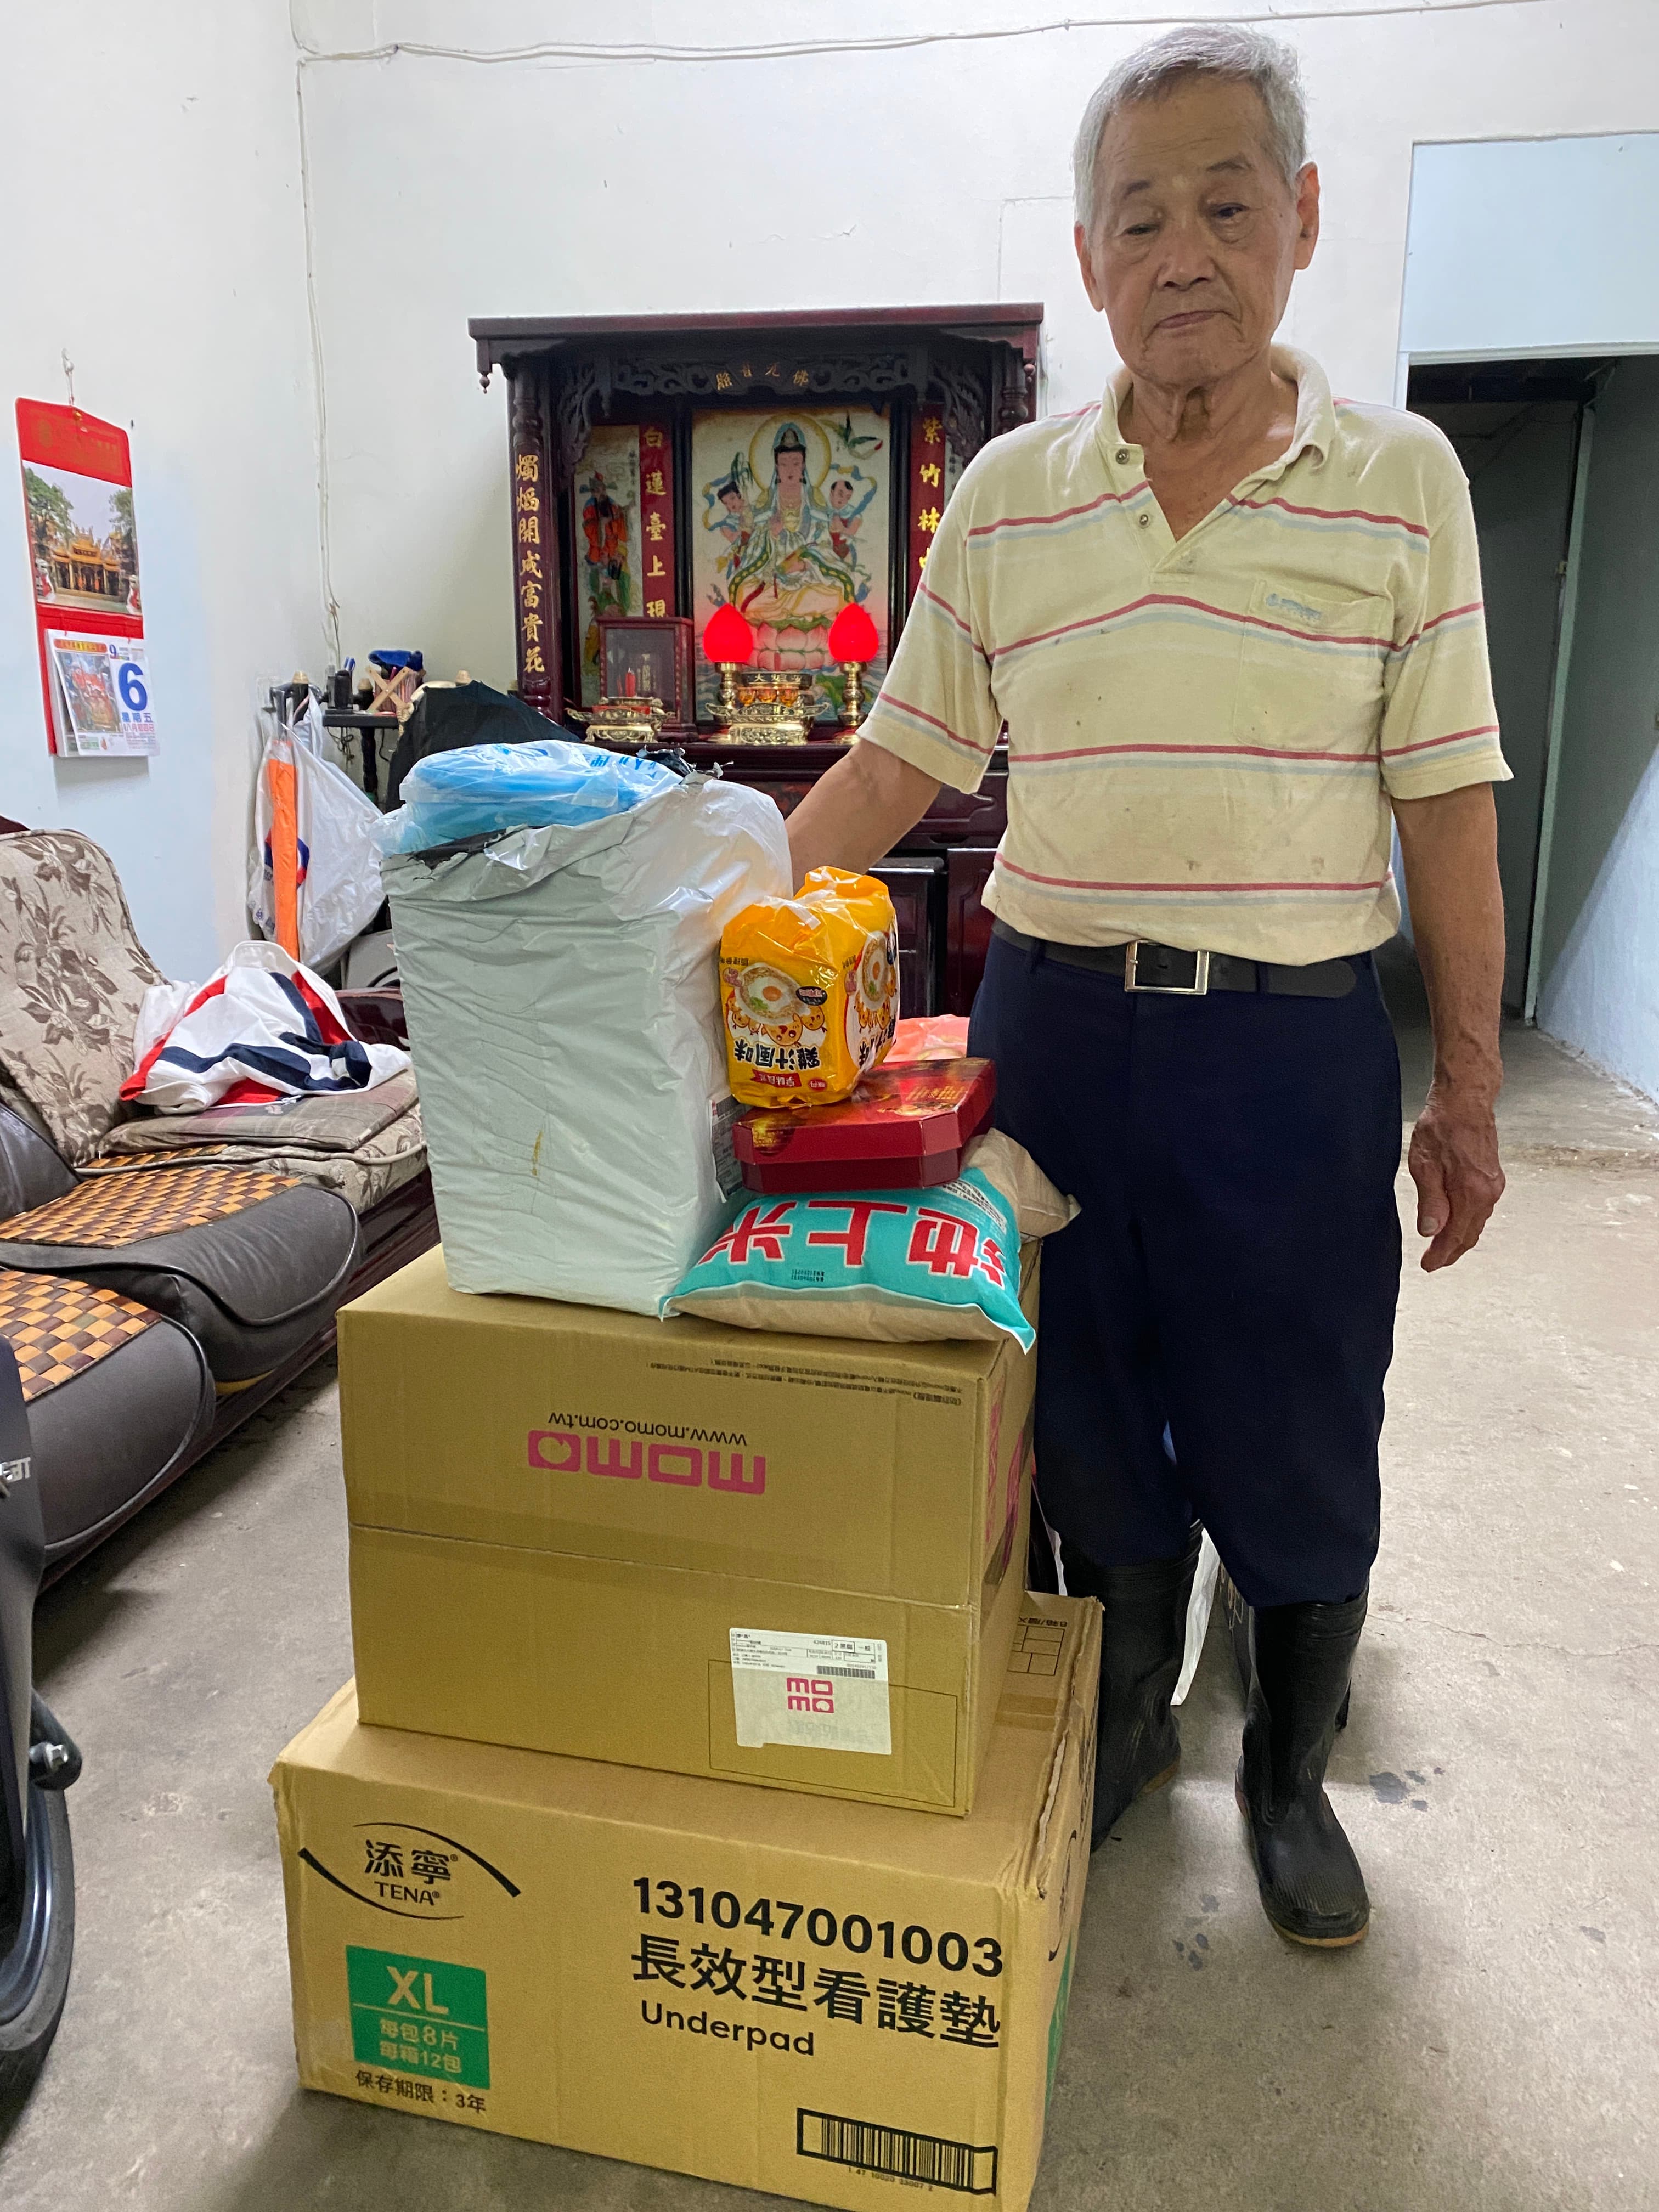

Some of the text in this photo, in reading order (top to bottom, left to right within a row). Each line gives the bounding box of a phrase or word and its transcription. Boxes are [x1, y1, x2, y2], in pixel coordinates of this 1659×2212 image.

[118, 662, 148, 712] 6
[122, 712, 154, 723] 星期五
[732, 1039, 822, 1071] 雞汁風味
[698, 1199, 1007, 1289] 池上米
[548, 1412, 747, 1447] www.momo.com.tw
[528, 1430, 766, 1496] momo
[633, 1877, 1003, 1978] 131047001003
[387, 1966, 450, 2015] XL
[631, 1934, 1001, 2049] 長效型看護墊
[379, 2019, 460, 2051] 每包8片
[640, 1998, 816, 2056] Underpad
